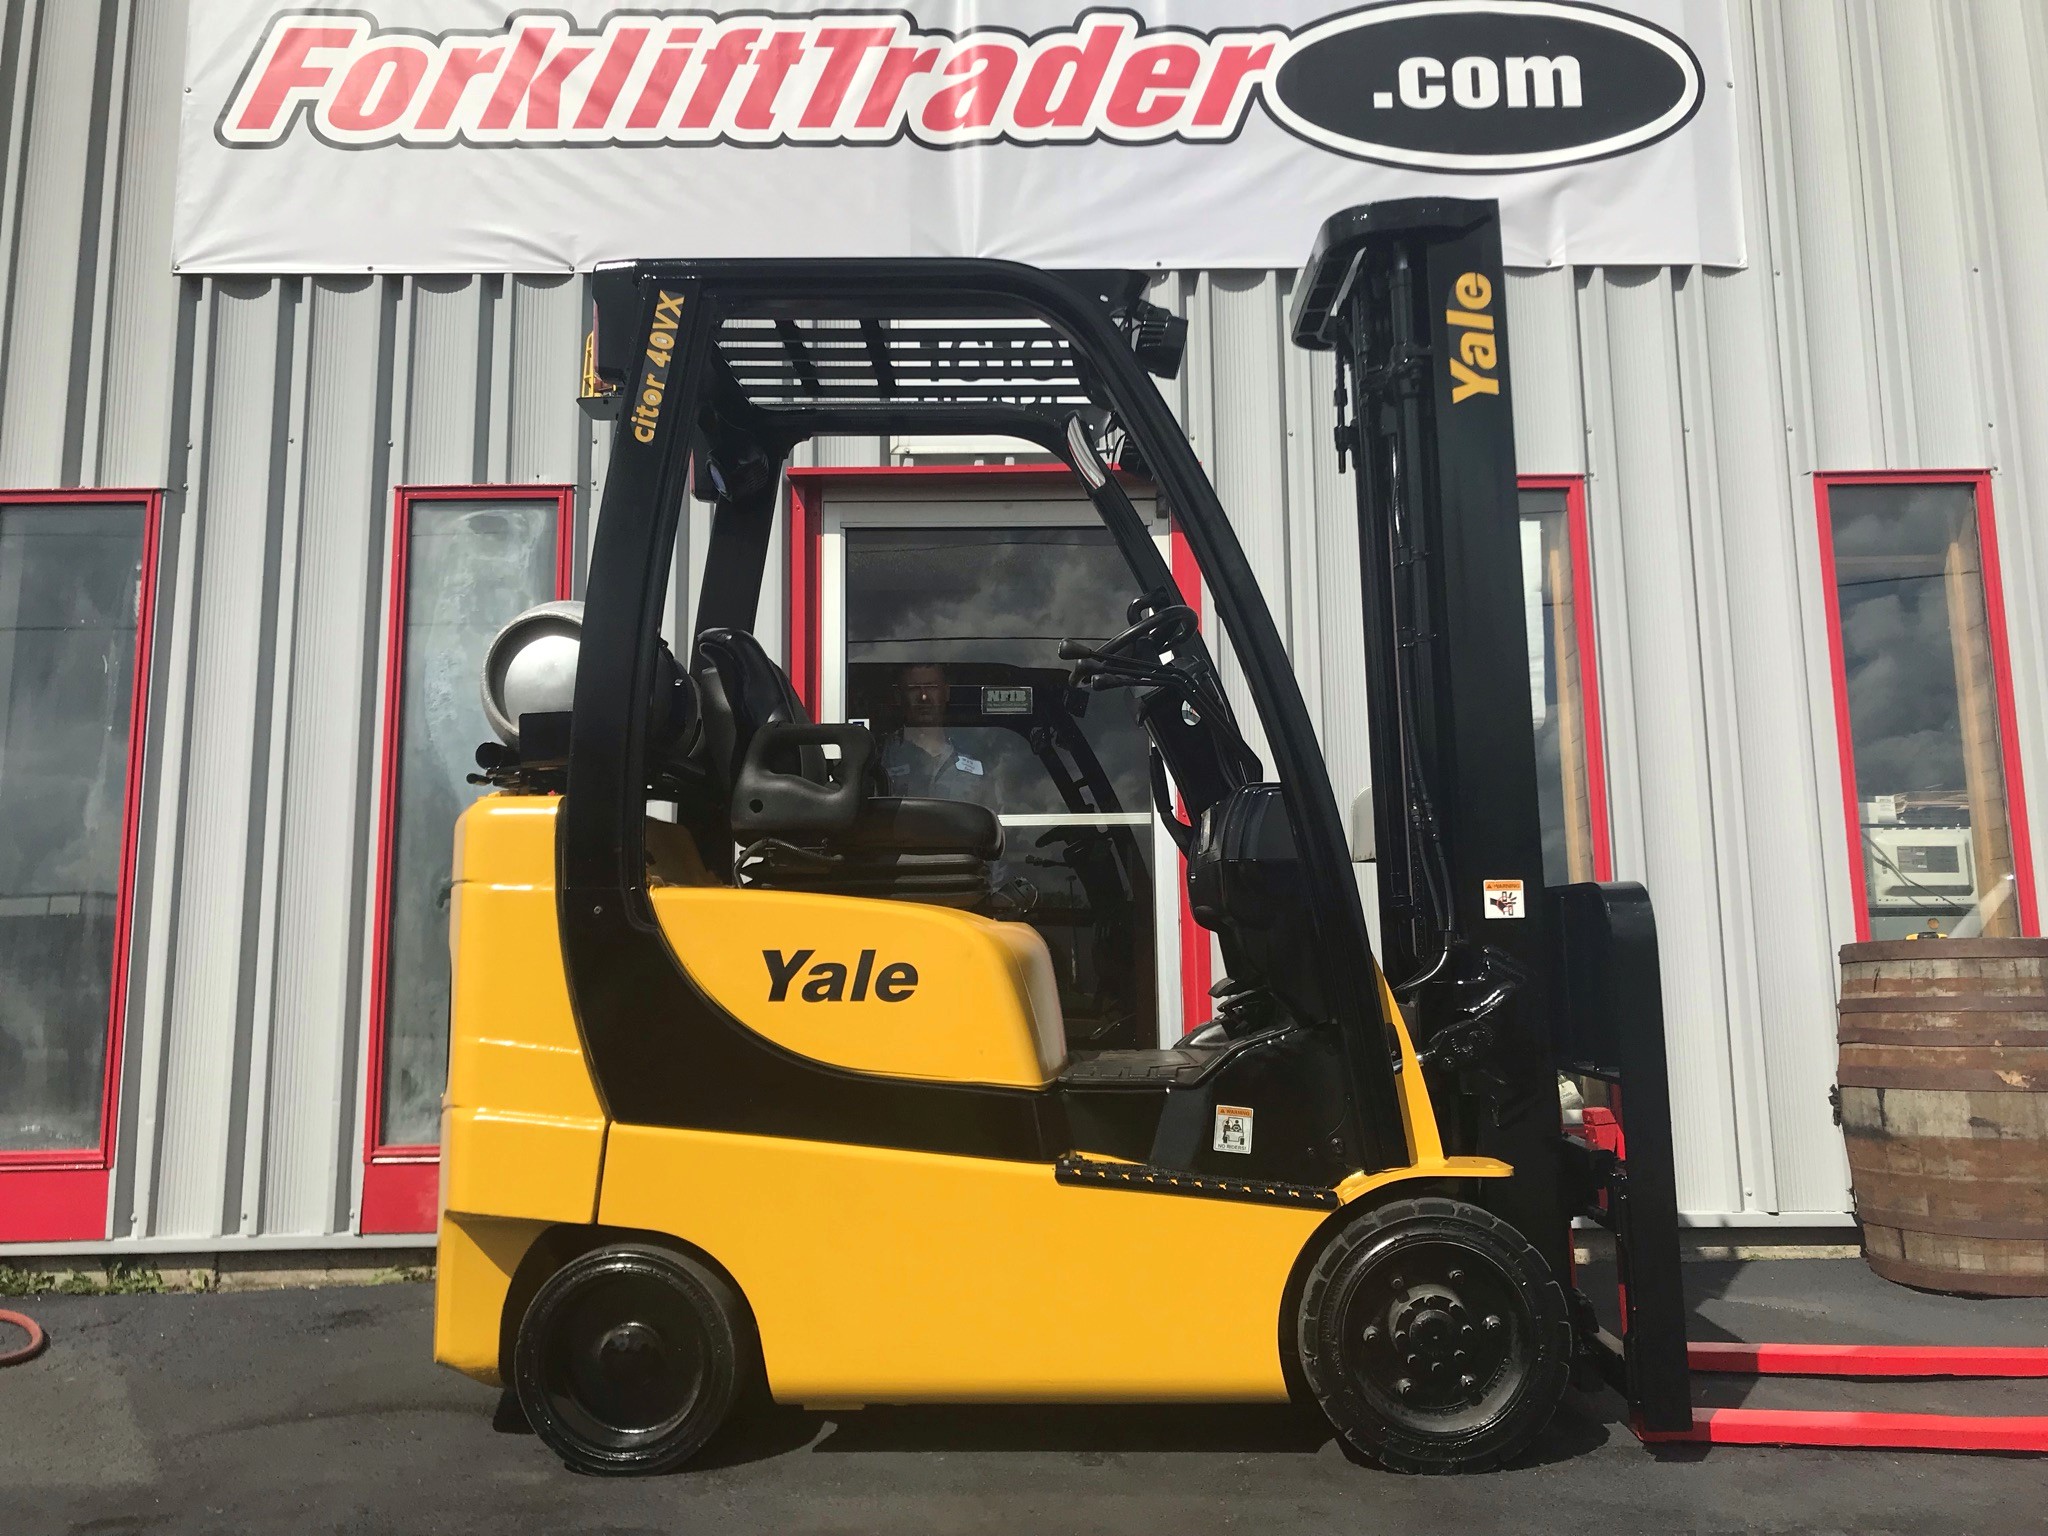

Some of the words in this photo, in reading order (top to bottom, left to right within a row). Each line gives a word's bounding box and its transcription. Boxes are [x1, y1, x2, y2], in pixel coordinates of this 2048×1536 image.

[236, 24, 1275, 132] ForkliftTrader
[1372, 54, 1584, 110] .com
[646, 289, 685, 368] 40VX
[1446, 272, 1499, 404] Yale
[630, 374, 666, 443] citor
[986, 690, 1027, 702] NFIB
[761, 949, 919, 1003] Yale
